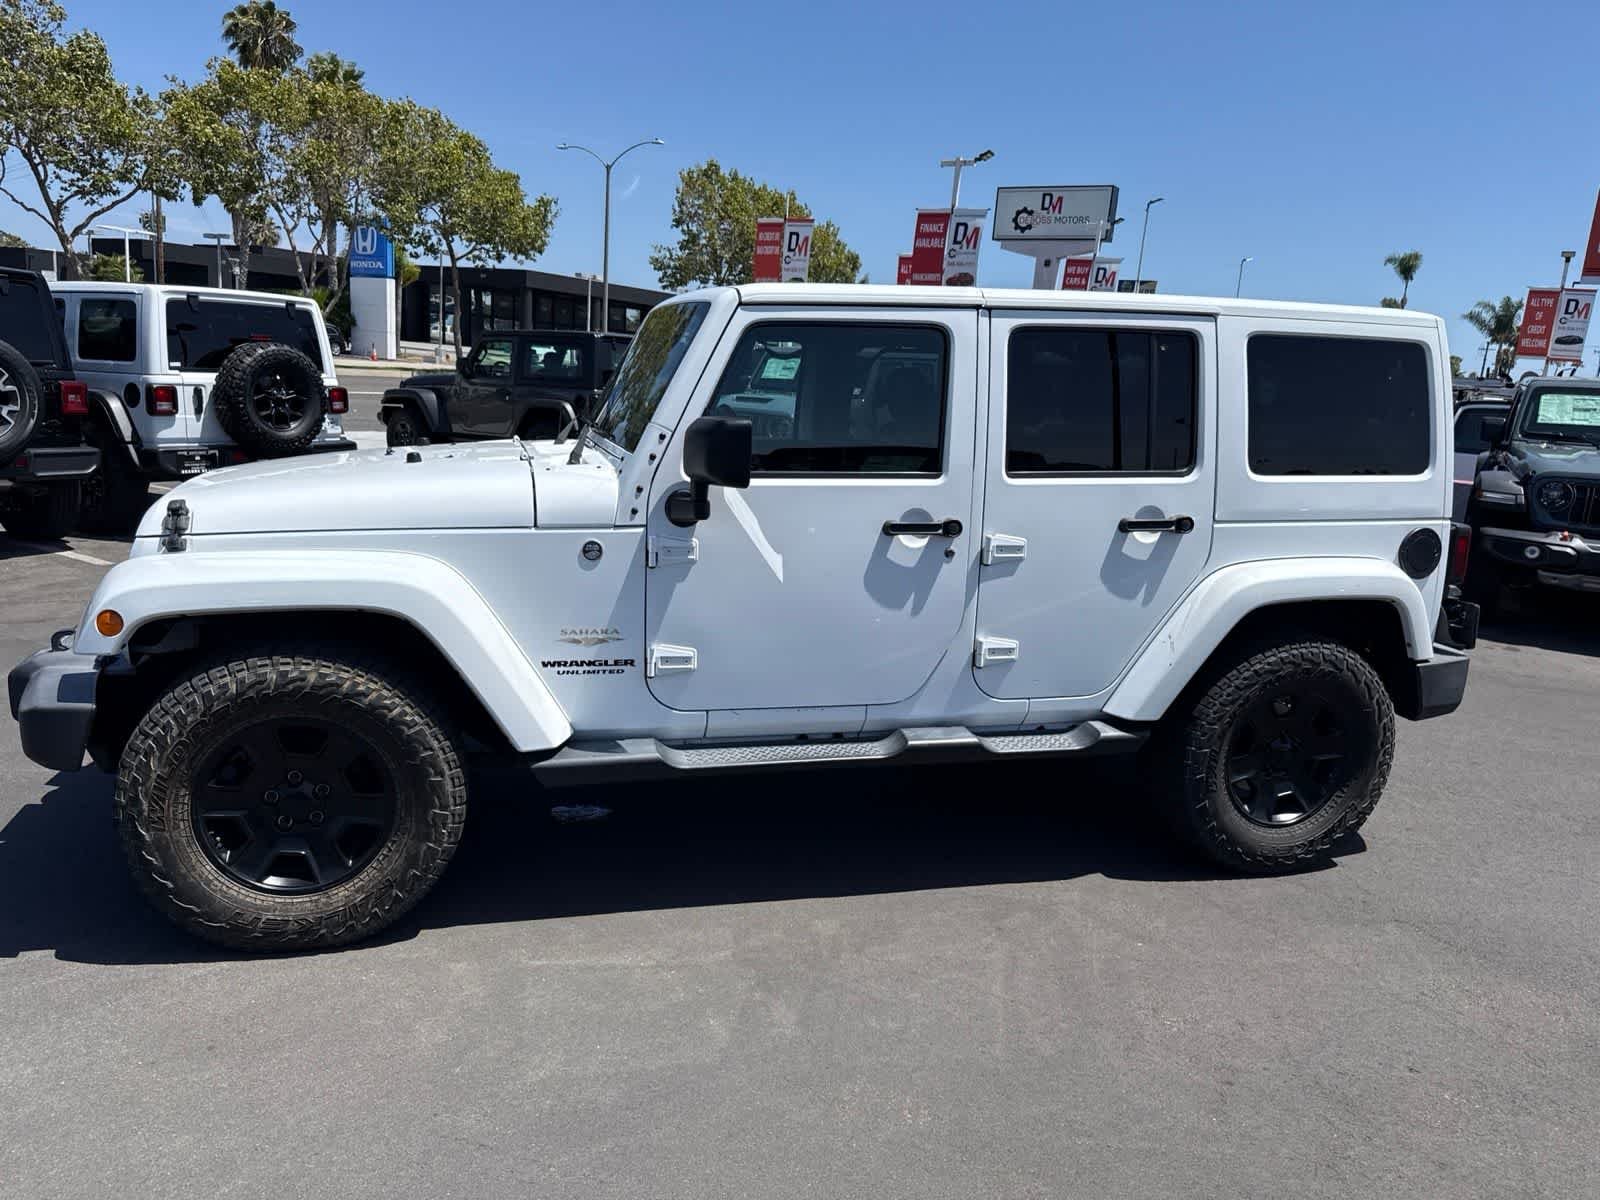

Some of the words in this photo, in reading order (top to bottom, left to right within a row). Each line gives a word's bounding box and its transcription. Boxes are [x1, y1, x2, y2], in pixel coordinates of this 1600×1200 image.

[1054, 215, 1090, 225] MOTORS
[919, 223, 945, 233] FINANCE
[915, 238, 945, 249] AVAILABLE
[1067, 266, 1077, 274] WE
[1077, 267, 1089, 275] BUY
[1066, 277, 1081, 286] CARS
[1531, 298, 1539, 306] ALL
[1541, 299, 1553, 307] TYPE
[1536, 312, 1543, 320] OF
[1528, 326, 1546, 334] CREDIT
[1522, 339, 1547, 347] WELCOME
[560, 628, 620, 636] SAHARA
[541, 658, 636, 668] WRANGLER
[557, 668, 625, 676] UNLIMITED
